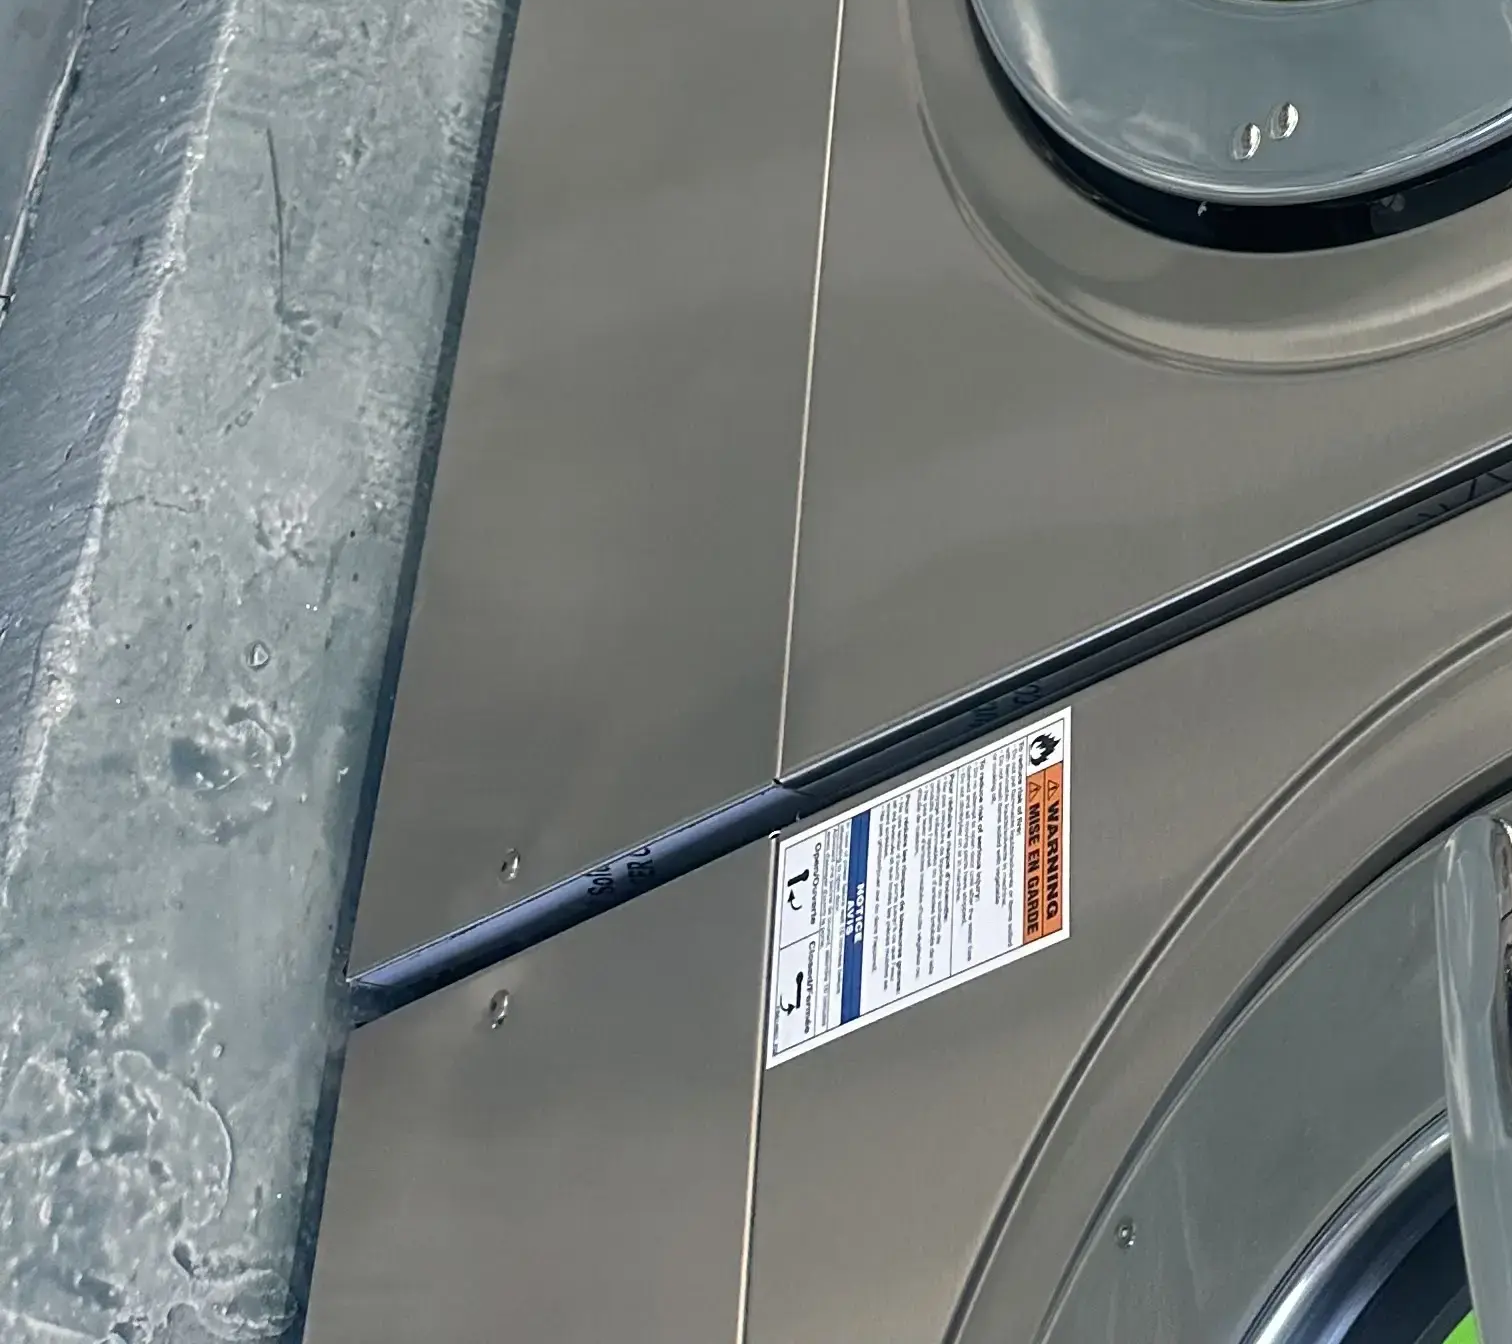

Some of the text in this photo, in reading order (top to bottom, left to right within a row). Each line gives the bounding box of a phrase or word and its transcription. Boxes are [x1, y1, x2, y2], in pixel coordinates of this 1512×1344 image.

[1026, 803, 1040, 935] MISE EN GARDE
[1045, 801, 1060, 922] WARNING
[845, 897, 856, 938] AVIS
[853, 881, 866, 945] NOTICE
